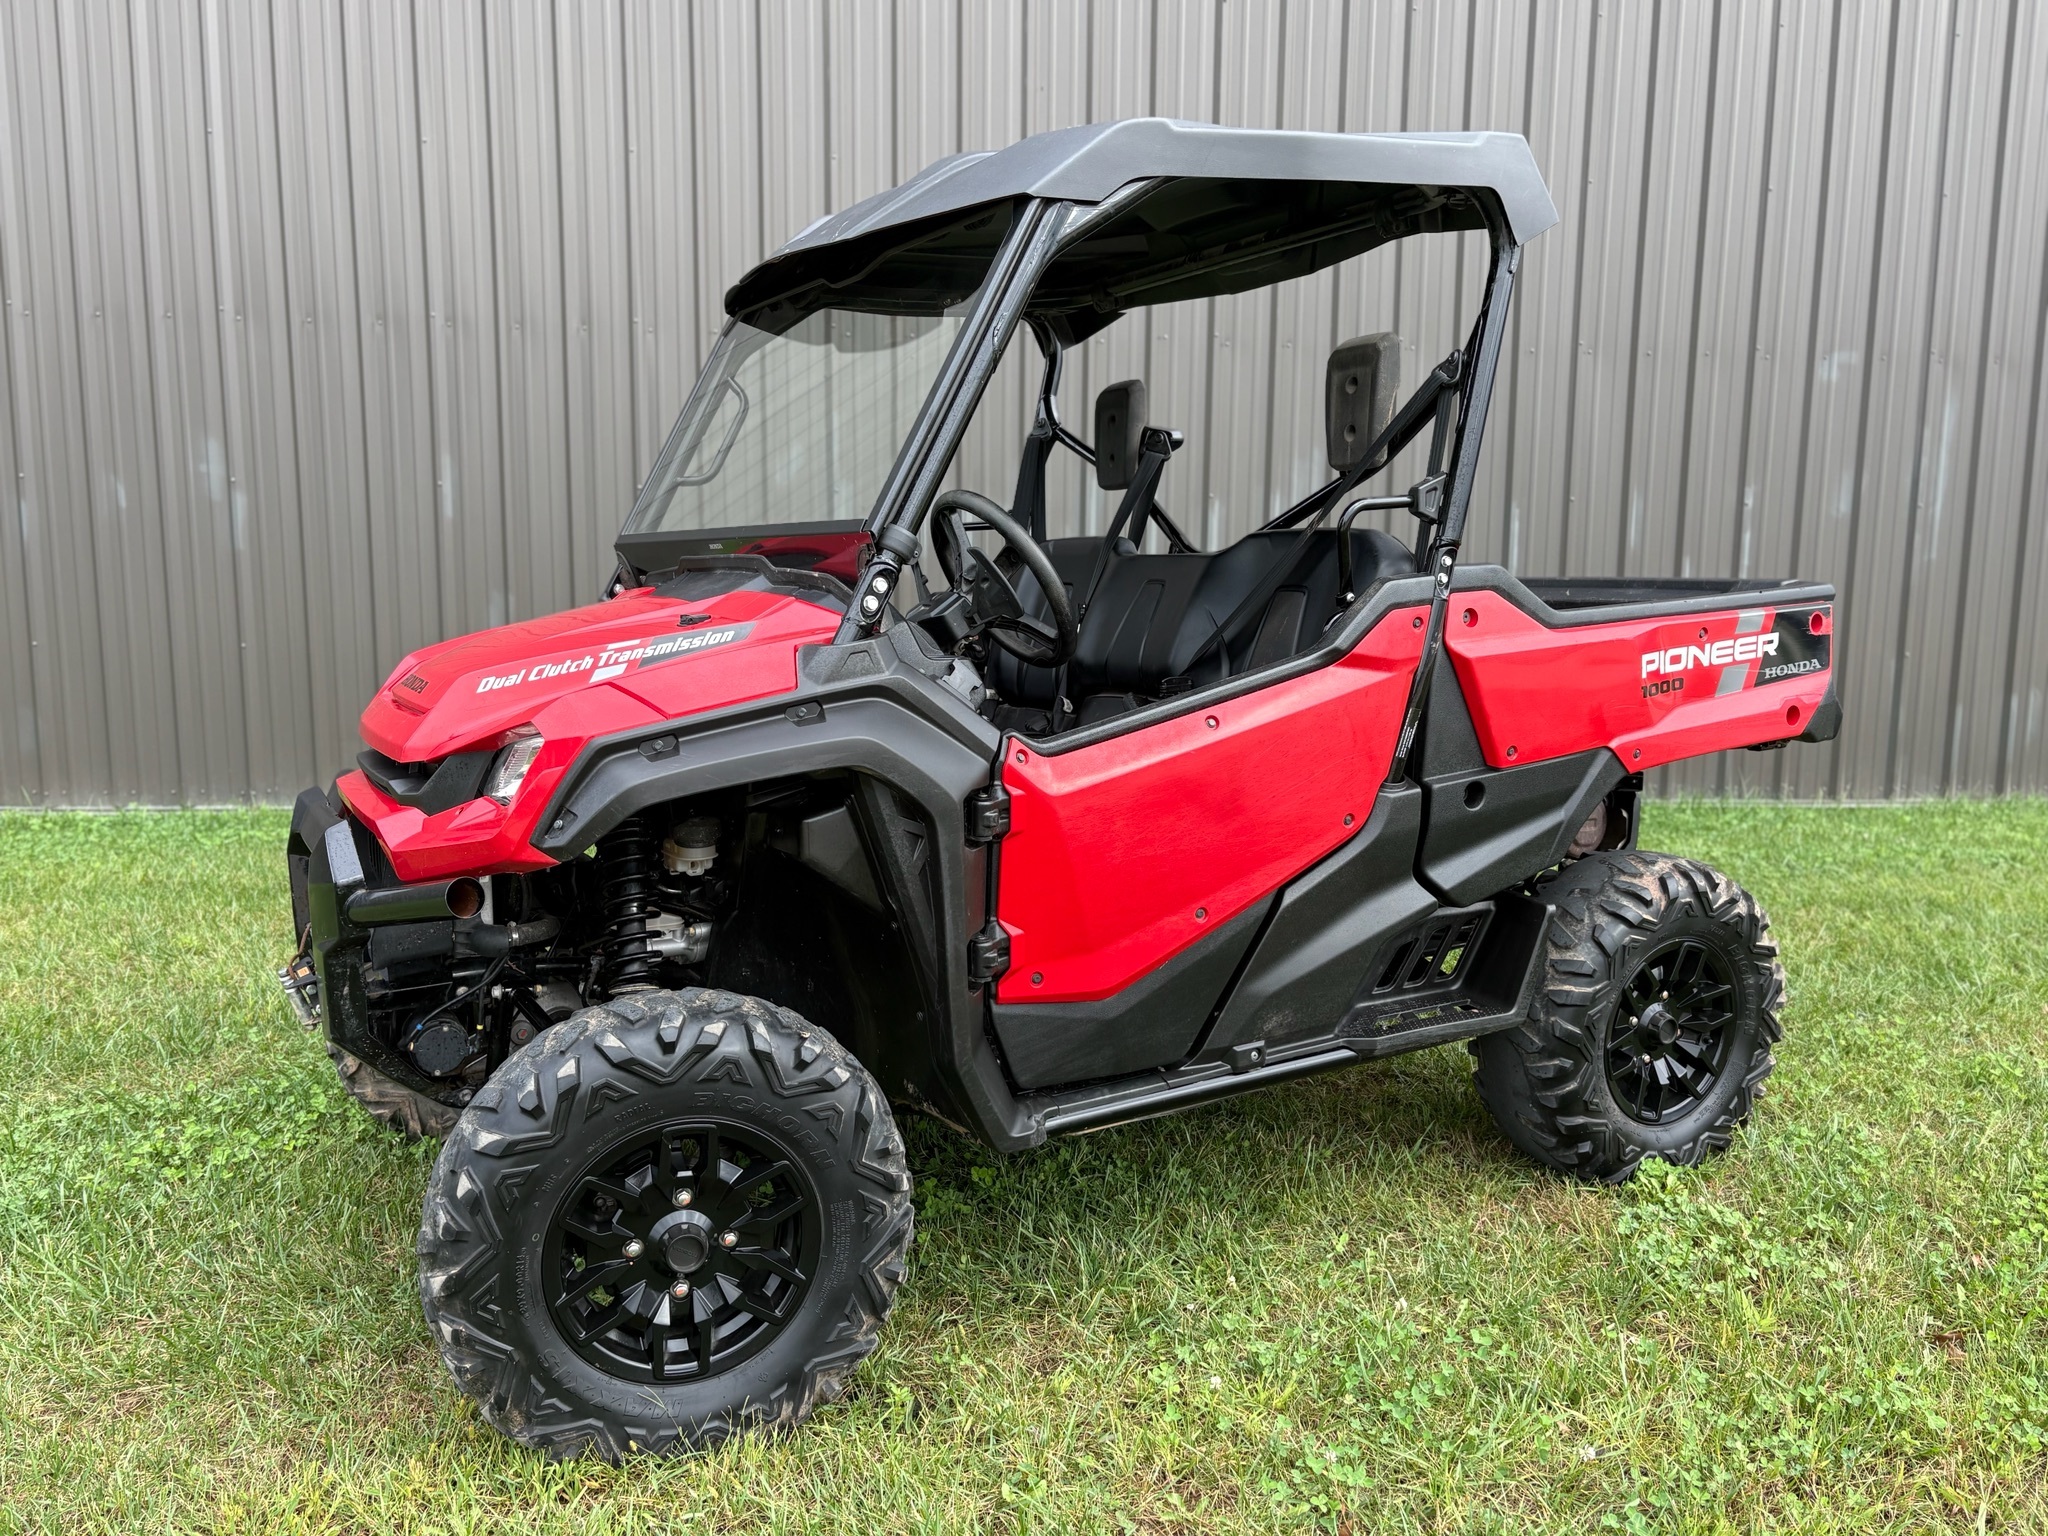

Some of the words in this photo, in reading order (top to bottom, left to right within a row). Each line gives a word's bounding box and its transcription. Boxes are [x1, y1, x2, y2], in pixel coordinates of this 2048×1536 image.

[476, 669, 526, 694] Dual
[527, 656, 594, 682] Clutch
[598, 630, 736, 666] Transmission
[1641, 631, 1780, 679] PIONEER
[1763, 658, 1822, 680] HONDA
[401, 674, 429, 694] HONDA
[1641, 677, 1685, 698] 1000
[692, 1090, 838, 1170] BIGHORN
[536, 1347, 685, 1420] MAXXIS
